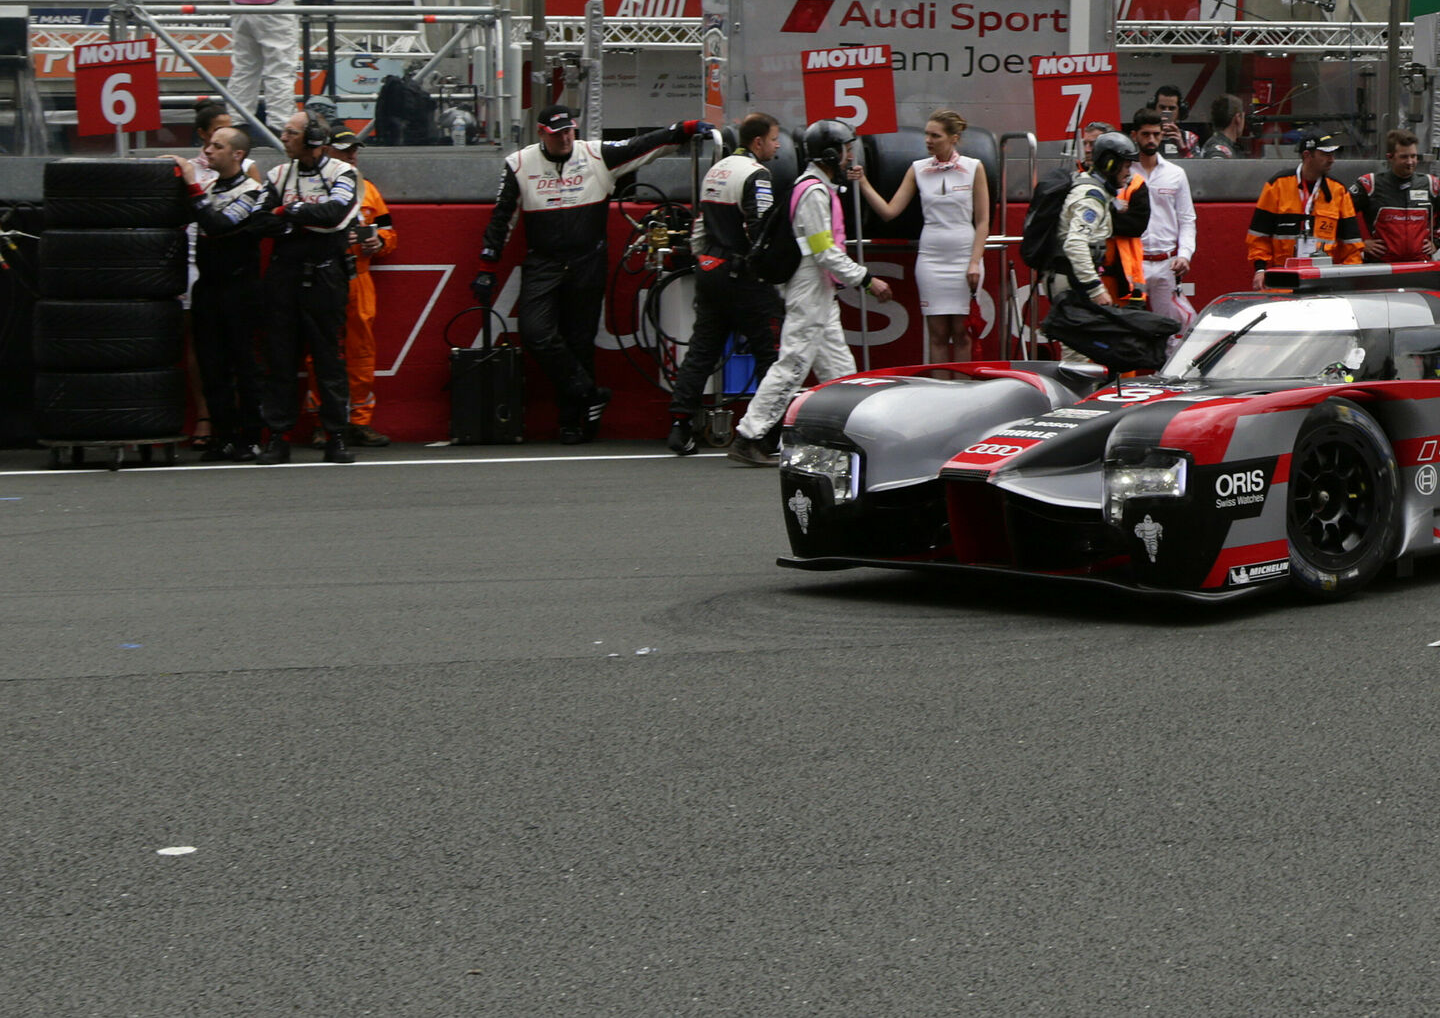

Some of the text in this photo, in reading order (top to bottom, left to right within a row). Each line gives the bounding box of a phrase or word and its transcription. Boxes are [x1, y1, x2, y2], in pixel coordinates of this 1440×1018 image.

[39, 14, 83, 23] MANS
[840, 0, 1068, 38] Audi Sport
[78, 41, 152, 65] MOTUL
[807, 47, 886, 69] MOTUL
[1037, 55, 1112, 75] MOTUL
[101, 73, 136, 125] 6
[834, 77, 868, 129] 5
[1061, 84, 1092, 133] 7
[536, 175, 584, 190] DENSO
[999, 429, 1059, 439] MAHLE
[1034, 421, 1079, 429] BOSCH
[1215, 469, 1264, 497] ORIS
[1216, 494, 1265, 509] Swiss Watches
[1249, 562, 1290, 576] MICHELIN
